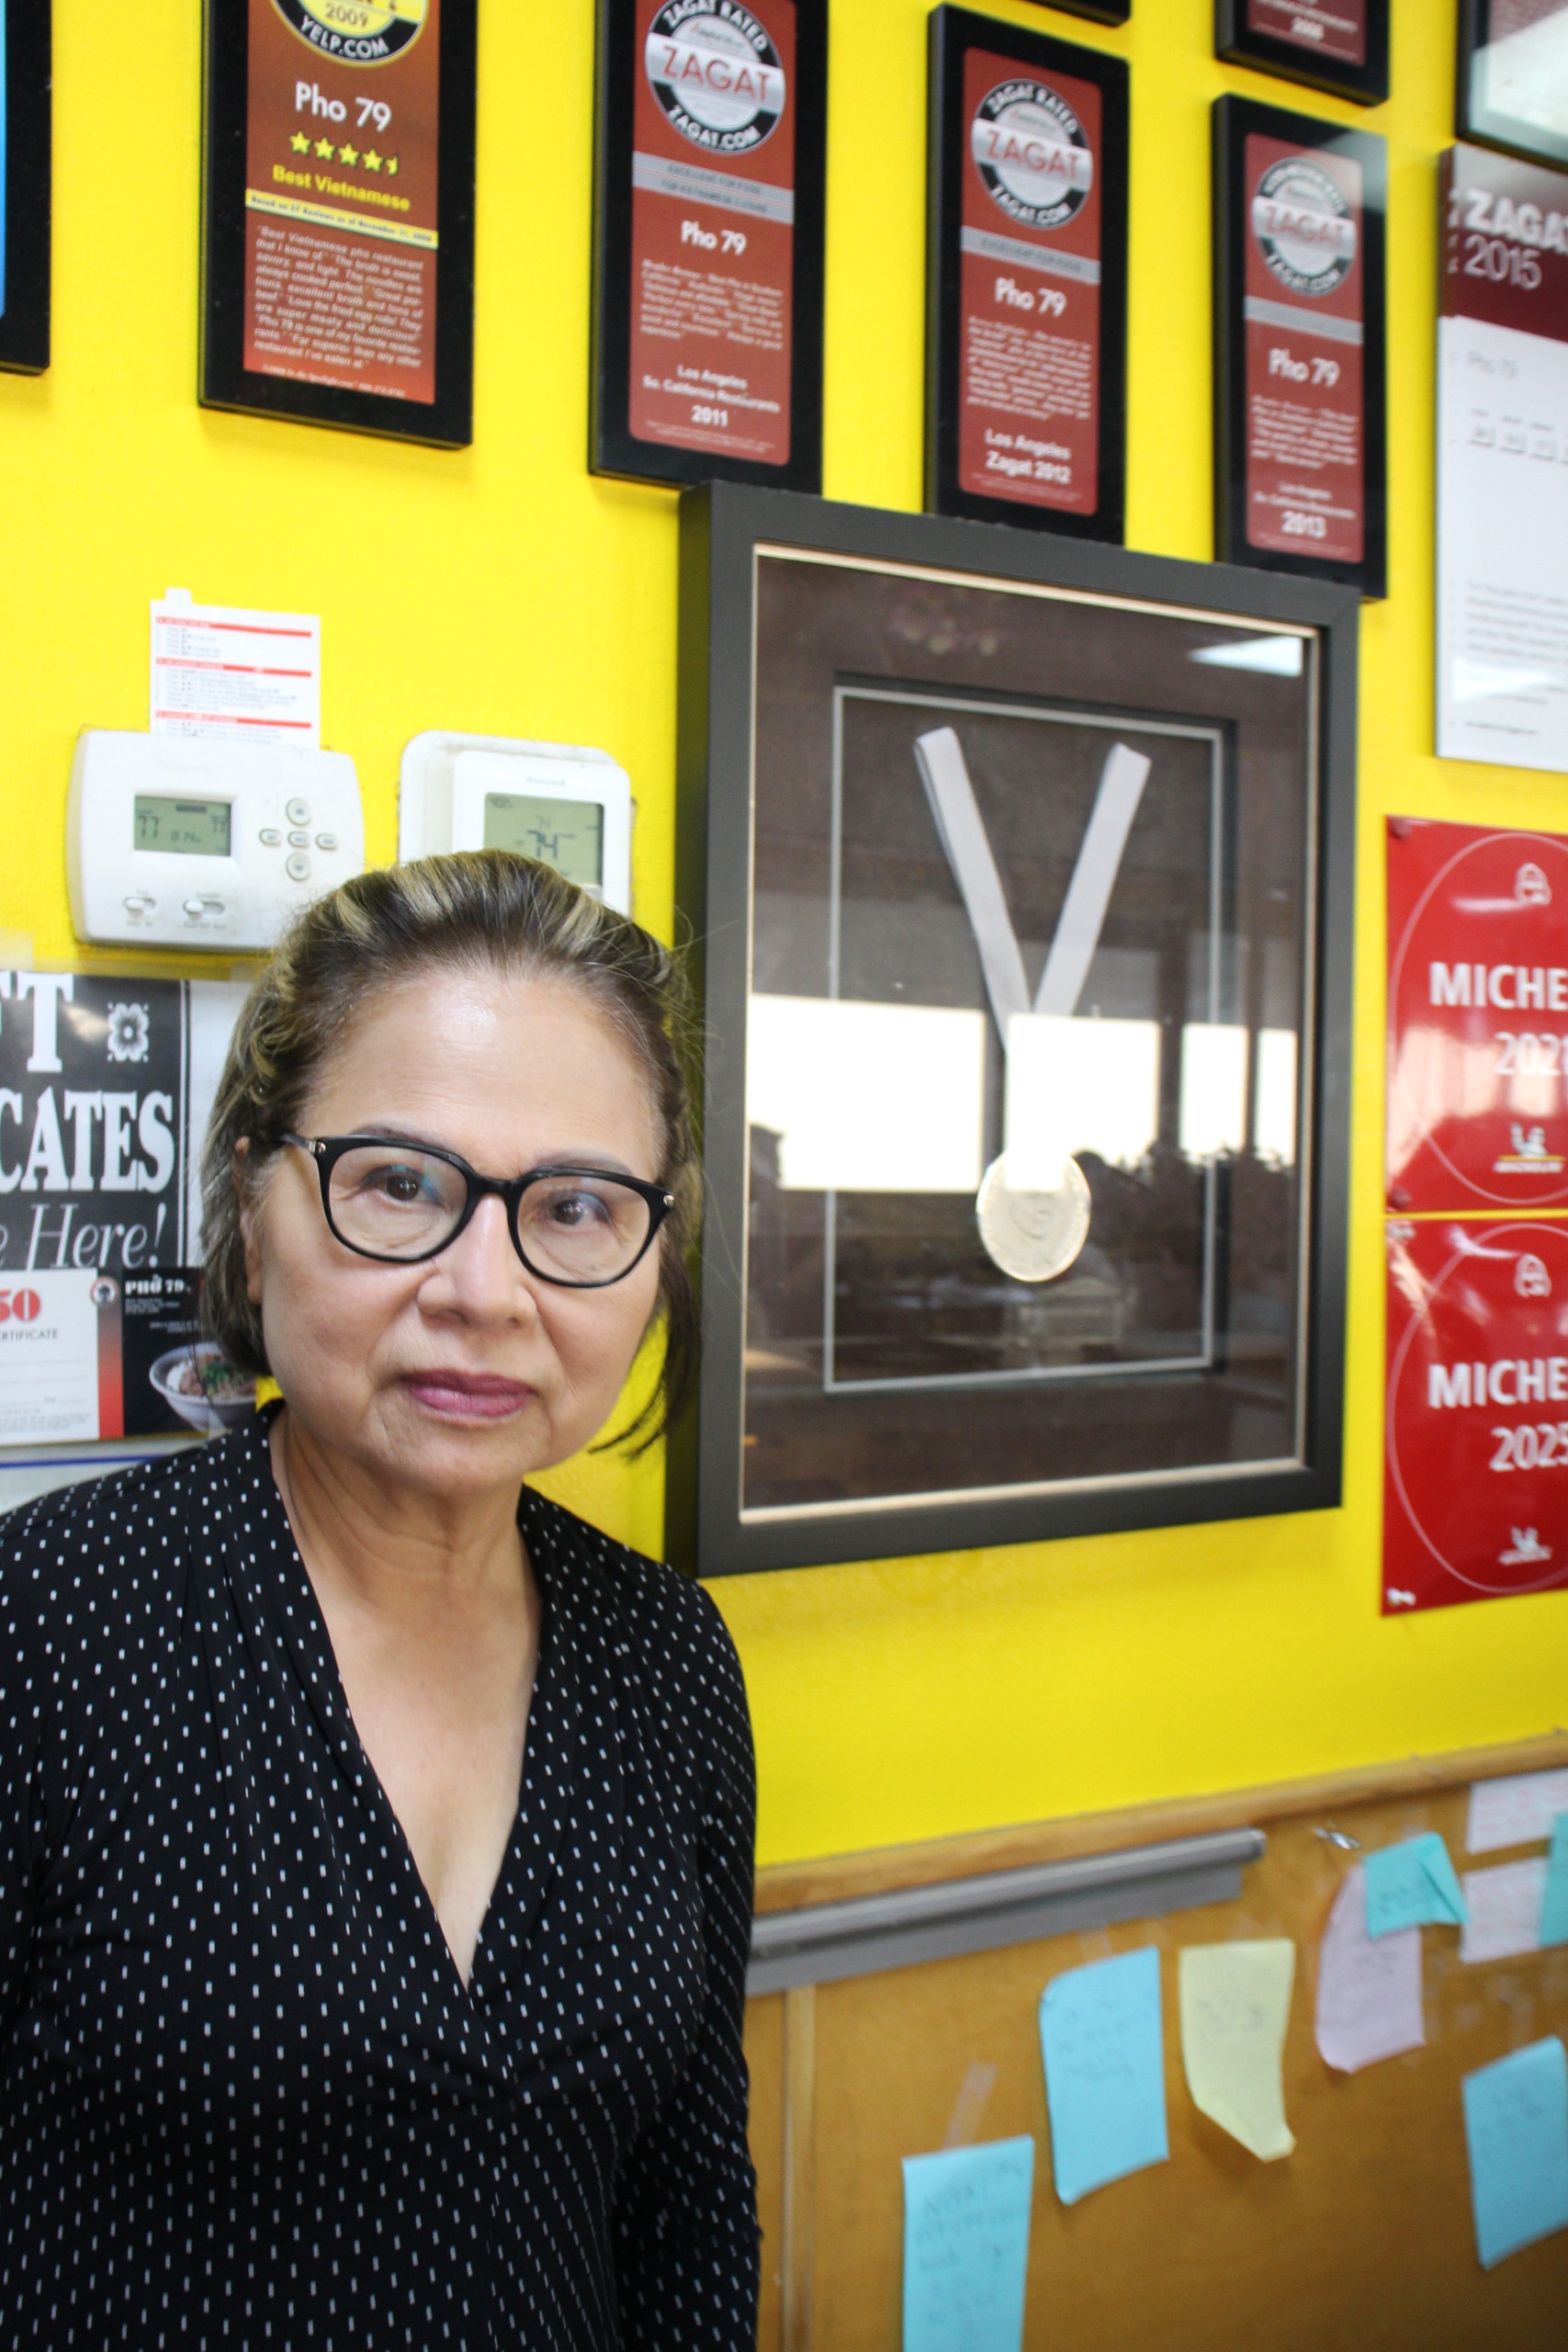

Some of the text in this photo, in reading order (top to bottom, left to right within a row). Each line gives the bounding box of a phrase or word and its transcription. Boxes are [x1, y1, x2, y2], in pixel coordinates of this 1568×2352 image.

[325, 3, 368, 28] 2009
[300, 15, 389, 59] YELP.COM
[662, 44, 771, 102] ZAGAT
[295, 81, 392, 132] Pho 79
[668, 104, 761, 151] ZAGAT.COM
[986, 130, 1079, 181] ZAGAT
[272, 164, 412, 212] Best Vietnamese
[681, 220, 747, 255] Pho 79
[1263, 206, 1344, 250] ZAGAT
[1463, 187, 1568, 257] ZAGA
[256, 239, 276, 251] that
[284, 243, 310, 258] know
[355, 260, 379, 274] broth
[288, 232, 347, 254] Vietnamese
[350, 247, 370, 261] pho
[372, 253, 423, 270] restaurant
[1463, 233, 1543, 290] 2015
[255, 264, 289, 279] always
[291, 272, 327, 287] cooked
[295, 260, 315, 272] and
[345, 269, 364, 283] The
[366, 276, 403, 291] noodles
[406, 284, 423, 295] are
[288, 283, 333, 301] excellent
[336, 292, 362, 308] broth
[366, 300, 386, 312] and
[388, 303, 410, 317] tons
[412, 309, 423, 320] of
[995, 277, 1066, 317] Pho 79
[255, 301, 274, 314] are
[276, 306, 307, 321] super
[310, 312, 344, 330] meaty
[345, 320, 366, 333] and
[281, 317, 294, 331] 79
[305, 324, 324, 336] one
[325, 327, 337, 340] of
[336, 331, 352, 345] my
[353, 333, 387, 349] favorite
[314, 300, 330, 312] the
[331, 302, 354, 318] fried
[354, 310, 374, 325] egg
[400, 317, 423, 334] They
[254, 340, 304, 358] restaurant
[324, 353, 353, 368] eaten
[311, 338, 352, 356] superior
[353, 345, 376, 359] than
[377, 351, 396, 367] any
[396, 355, 422, 369] other
[1268, 346, 1341, 388] Pho 79
[677, 364, 748, 390] Los Angeles
[692, 404, 728, 427] 2011
[985, 428, 1072, 461] Los Angeles
[1429, 960, 1568, 1011] MICHE
[26, 1202, 167, 1272] Here!
[1427, 1355, 1568, 1409] MICHE
